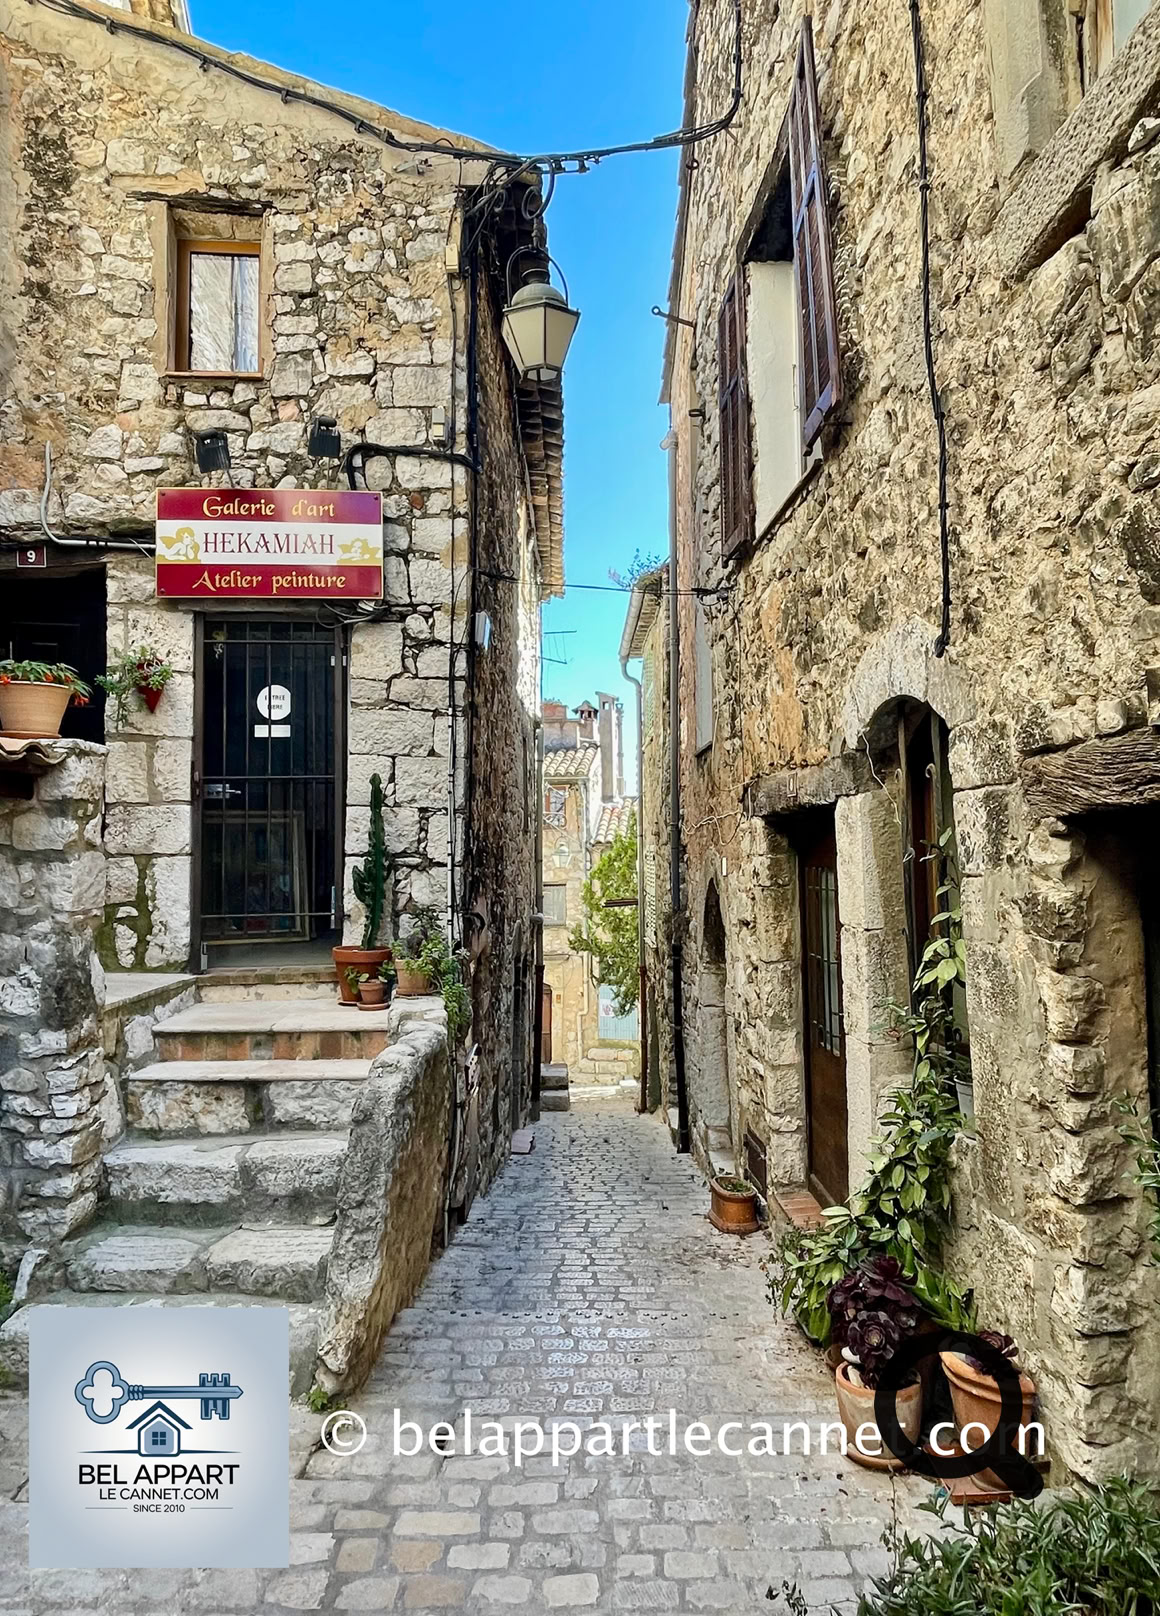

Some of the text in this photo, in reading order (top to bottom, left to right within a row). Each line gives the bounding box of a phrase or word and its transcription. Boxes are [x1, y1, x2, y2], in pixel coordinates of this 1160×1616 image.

[202, 496, 335, 518] Galerie d'art
[202, 532, 335, 554] HEKAMIAH
[27, 550, 36, 562] 9
[191, 570, 346, 594] Atelier peinture
